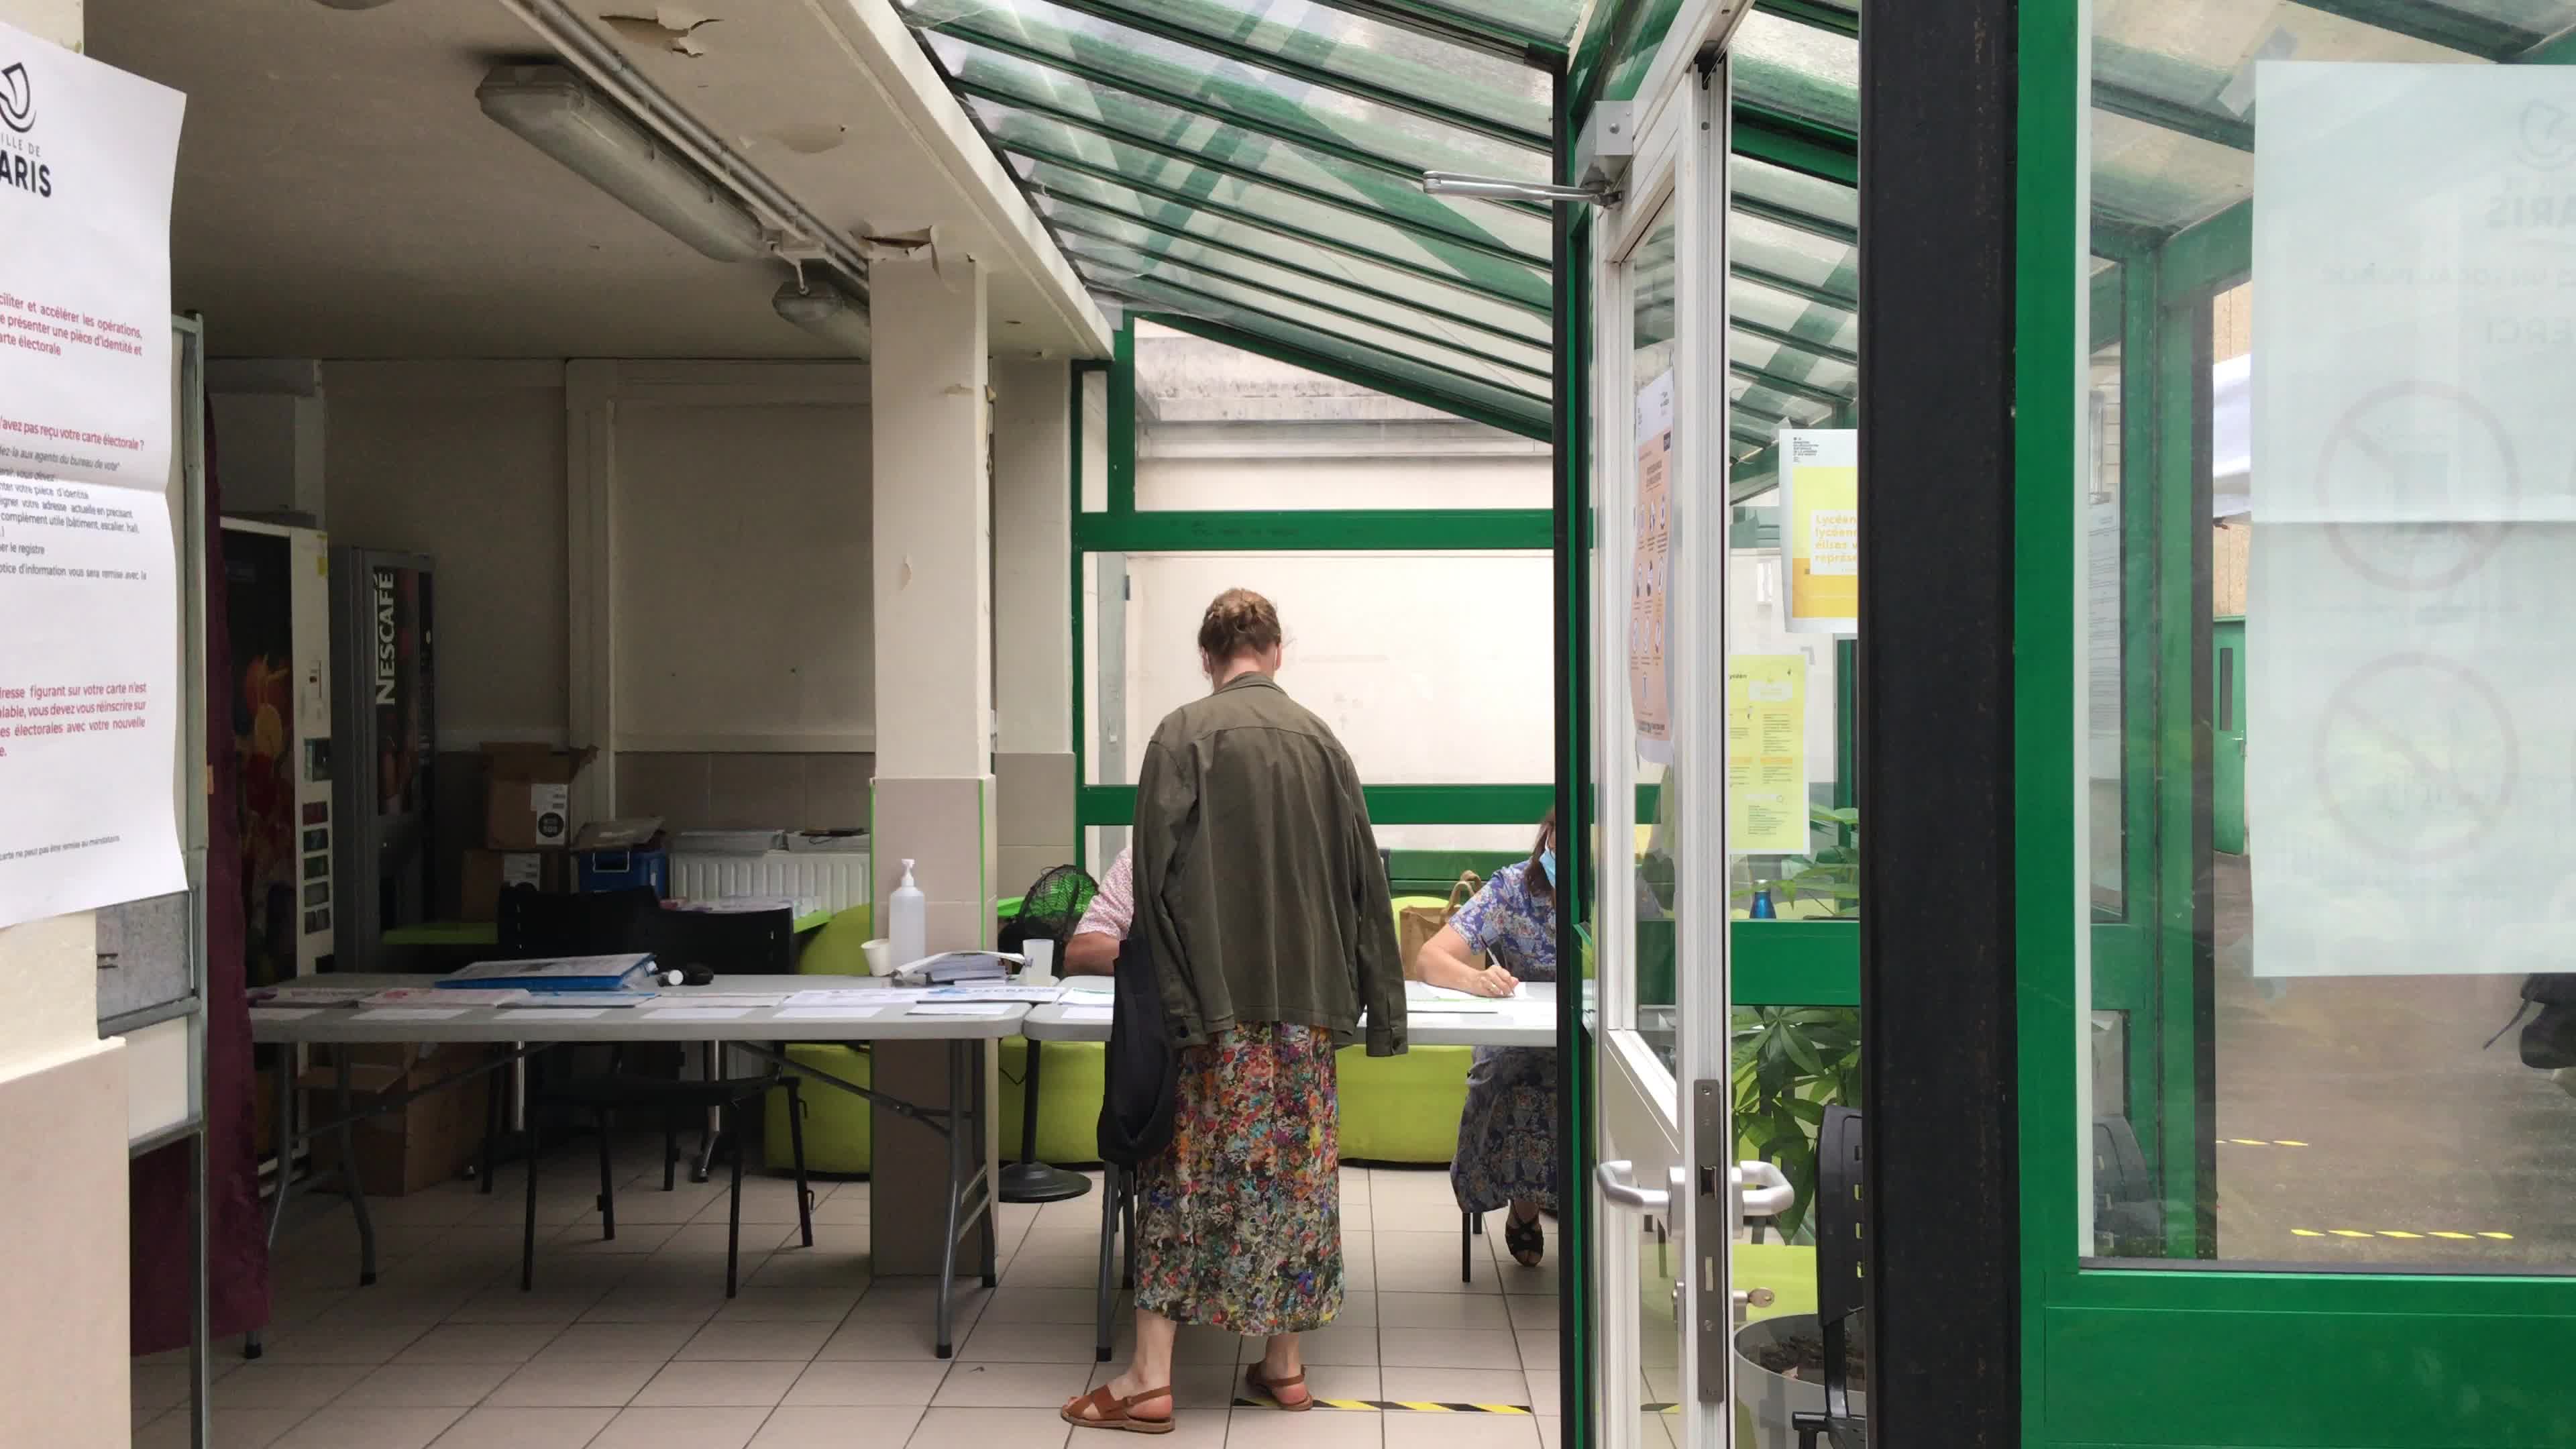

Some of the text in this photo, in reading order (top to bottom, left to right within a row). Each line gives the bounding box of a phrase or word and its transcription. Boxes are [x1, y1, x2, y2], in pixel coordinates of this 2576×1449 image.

[28, 143, 42, 158] DE
[28, 301, 36, 313] et
[40, 306, 79, 323] accélérer
[83, 312, 95, 327] les
[97, 319, 143, 341] opérations,
[7, 315, 50, 335] présenter
[52, 327, 68, 339] une
[70, 329, 93, 345] pièce
[95, 333, 133, 354] d'identité
[133, 345, 142, 356] et
[18, 337, 61, 356] électorale
[0, 415, 144, 451] 'avez pas reçu votre carte électorale ?
[20, 449, 34, 460] aux
[34, 450, 58, 464] agents
[60, 452, 69, 465] du
[70, 454, 94, 468] bureau
[95, 458, 103, 469] de
[15, 484, 33, 494] votre
[21, 498, 40, 508] votre
[42, 500, 67, 512] adresse
[97, 507, 106, 516] en
[1, 510, 48, 525] complément
[49, 515, 65, 526] utile
[10, 541, 17, 553] le
[18, 541, 46, 556] registre
[19, 563, 66, 576] d'information
[68, 568, 85, 578] vous
[374, 570, 396, 706] NESCAFÉ
[30, 684, 66, 700] figurant
[68, 686, 80, 696] sur
[83, 684, 104, 696] votre
[106, 684, 127, 695] carte
[128, 682, 147, 693] n'est
[28, 706, 49, 717] vous
[50, 702, 75, 716] devez
[76, 702, 95, 714] vous
[96, 698, 133, 713] réinscrire
[133, 701, 146, 710] sur
[14, 722, 64, 737] électorales
[66, 722, 86, 733] avec
[89, 720, 109, 731] votre
[113, 715, 146, 729] nouvelle
